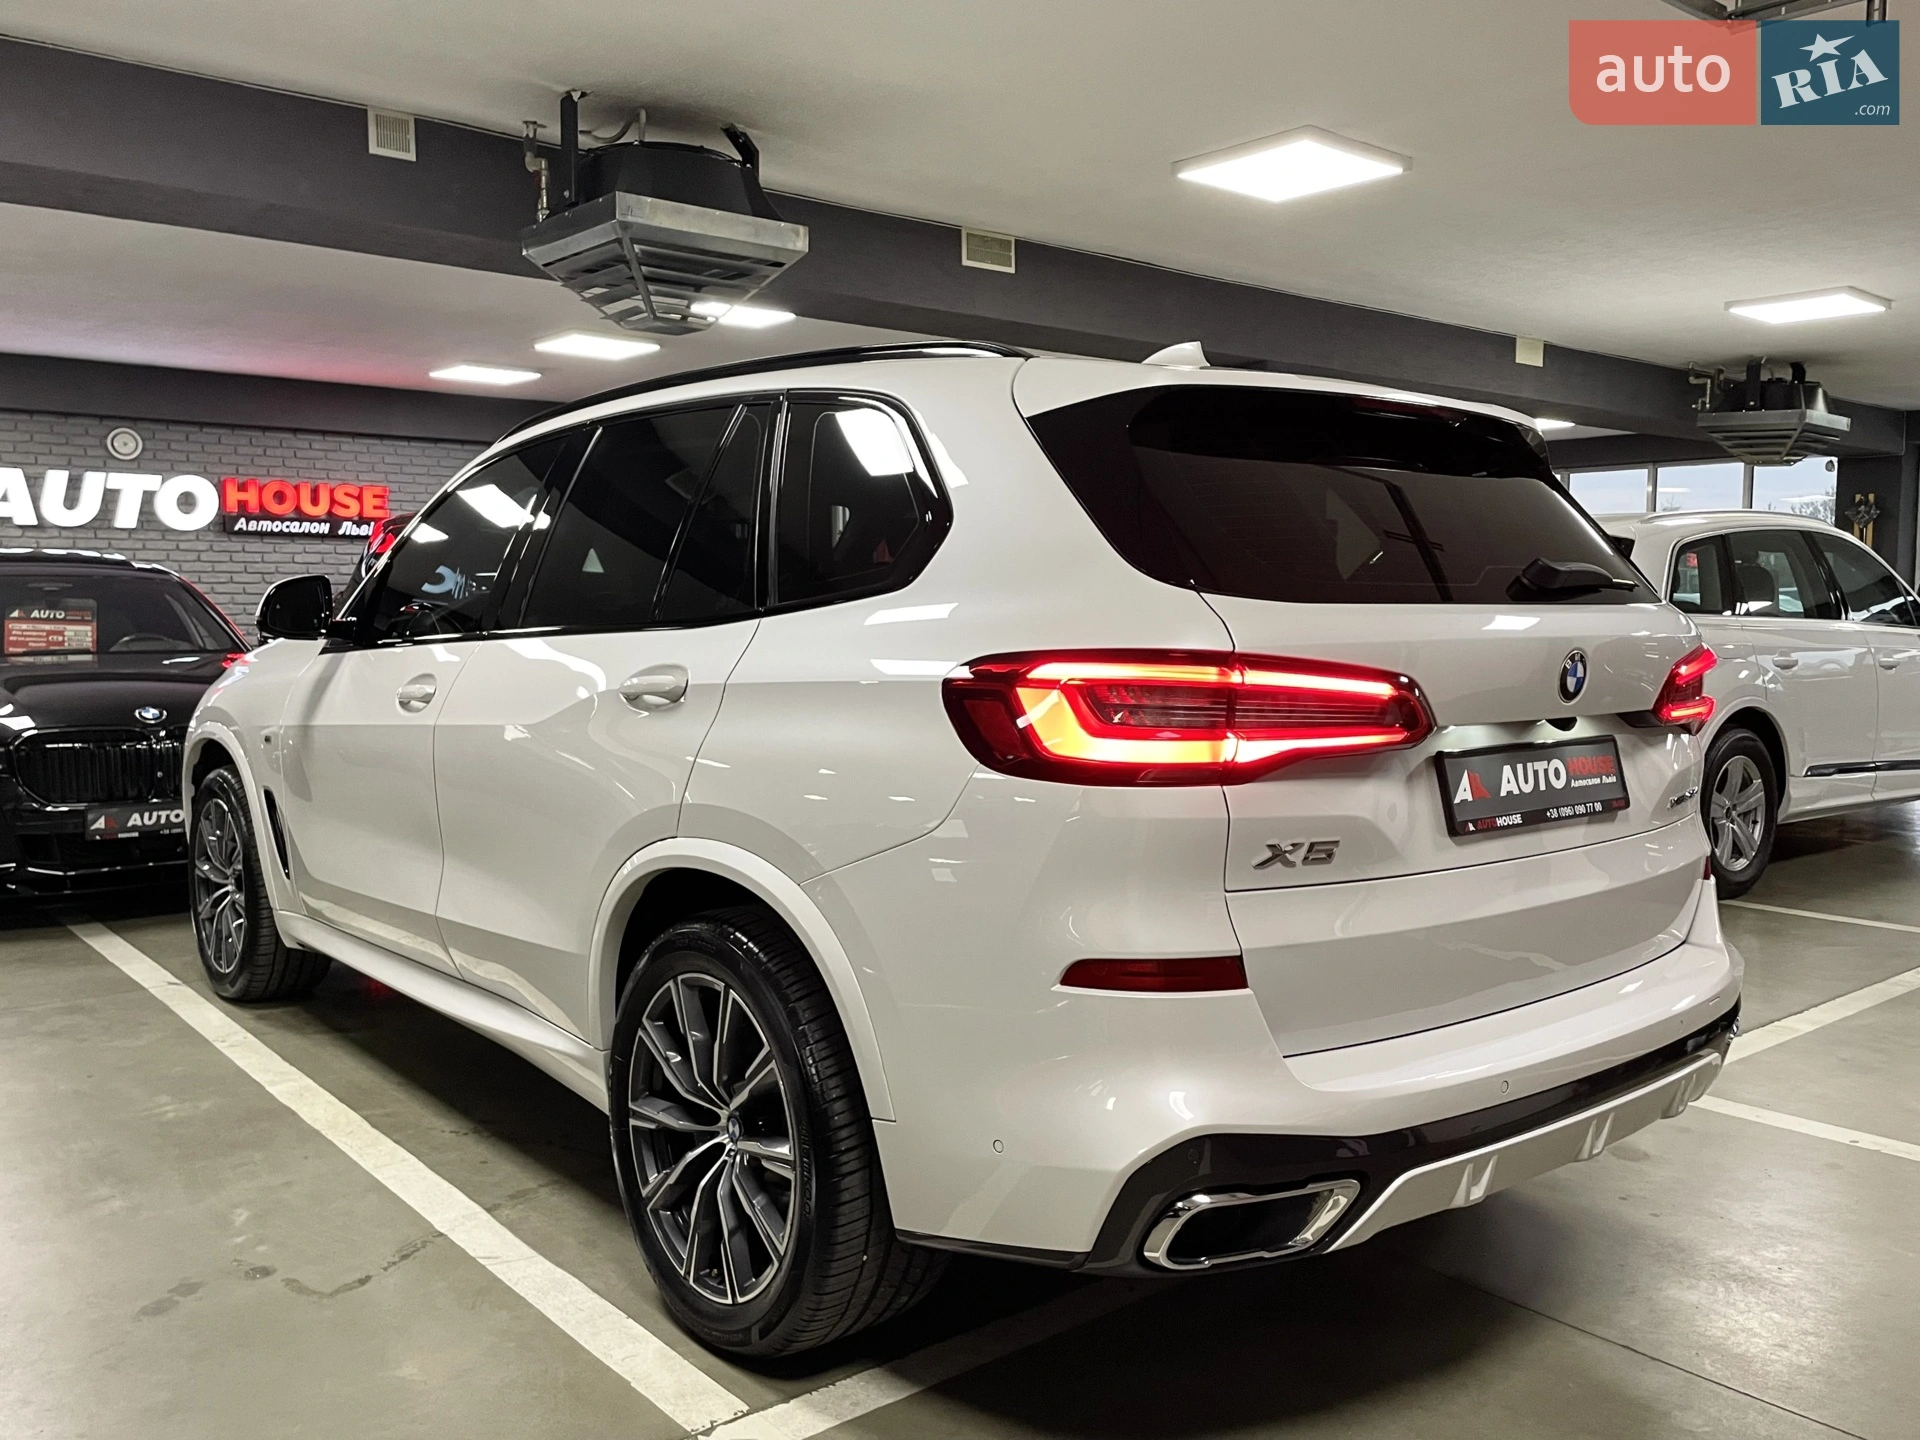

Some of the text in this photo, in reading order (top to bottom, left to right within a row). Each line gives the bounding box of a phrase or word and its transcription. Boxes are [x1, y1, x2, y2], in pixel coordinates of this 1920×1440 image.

[222, 477, 392, 519] HOUSE
[234, 517, 375, 536] Автосалон Льві
[30, 609, 66, 619] AUTO
[1500, 758, 1567, 797] AUTO
[1566, 755, 1616, 776] HOUSE
[126, 809, 186, 828] AUTO
[1546, 808, 1558, 818] +38
[1574, 804, 1586, 814] 090
[1586, 802, 1593, 812] 77
[1252, 840, 1341, 870] X5
